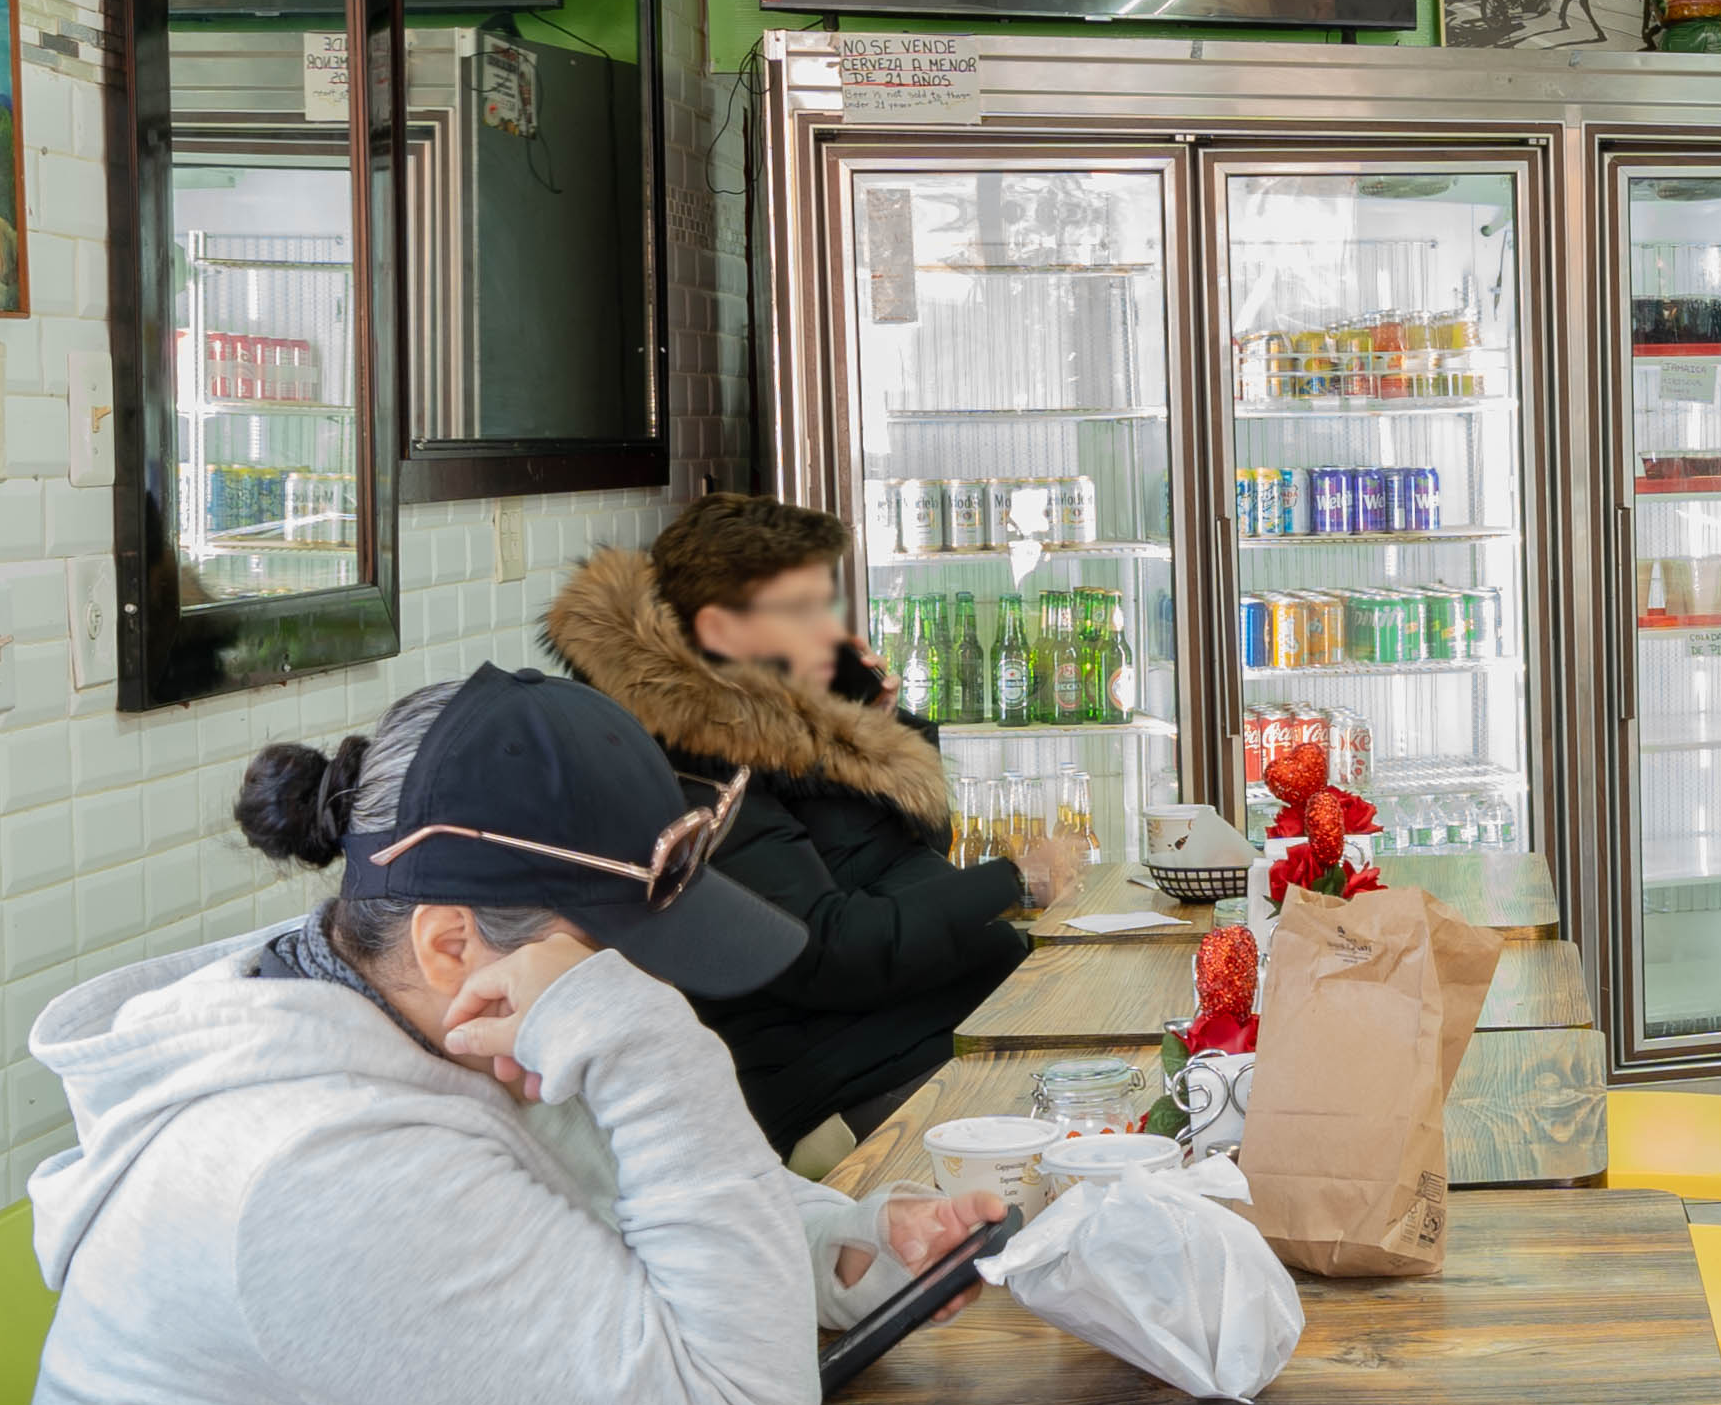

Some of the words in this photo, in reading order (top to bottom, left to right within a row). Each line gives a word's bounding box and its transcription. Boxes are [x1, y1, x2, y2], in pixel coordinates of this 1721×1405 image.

[843, 40, 866, 55] NO
[870, 40, 893, 55] SE
[901, 39, 956, 54] VENDE
[842, 58, 902, 71] CERVEZA
[912, 59, 922, 71] A
[929, 57, 976, 72] MENOR
[849, 72, 876, 84] DE
[885, 72, 902, 84] 21
